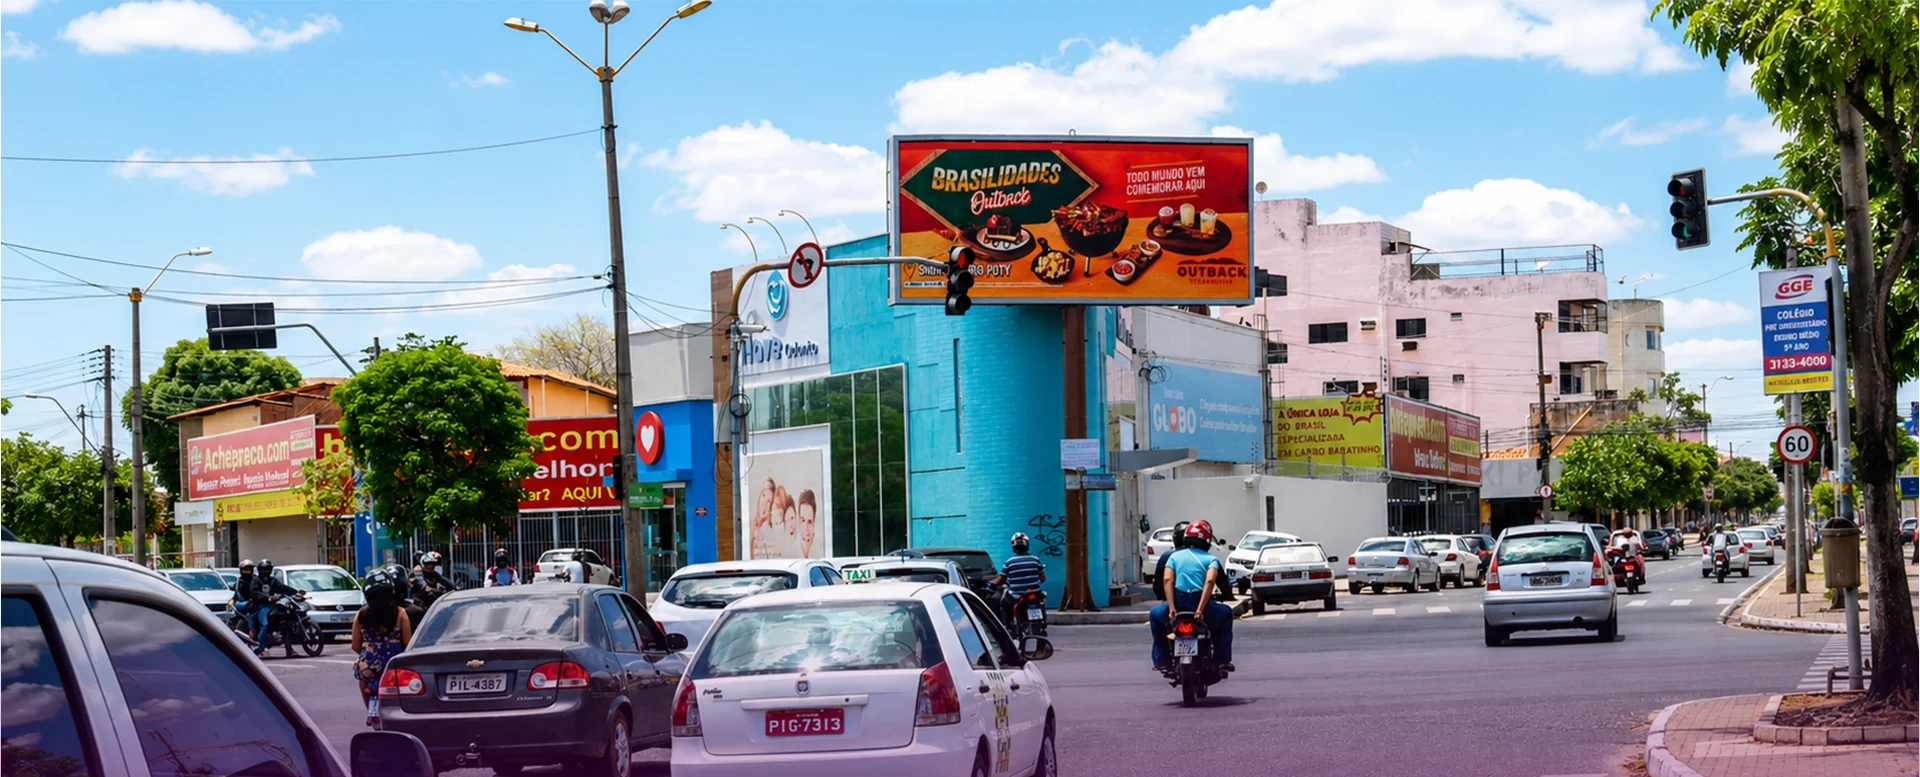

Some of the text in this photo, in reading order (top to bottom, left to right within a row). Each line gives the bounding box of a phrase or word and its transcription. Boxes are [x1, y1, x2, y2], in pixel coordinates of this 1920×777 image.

[932, 162, 1062, 192] BRASILIDADES
[1126, 166, 1205, 183] TODO MUNDO VEM
[1126, 178, 1206, 195] COMEMORAR AQUI
[1177, 266, 1247, 279] OUTBACK
[1777, 279, 1813, 295] GGE
[1153, 403, 1197, 435] GLOBO
[1318, 408, 1340, 418] LOJA
[1295, 421, 1326, 430] BRASIL
[1785, 435, 1809, 453] 60
[561, 486, 602, 503] AQUI
[844, 569, 872, 580] TAXI
[449, 679, 503, 691] PIL-4387
[769, 718, 841, 733] PIG-7313
